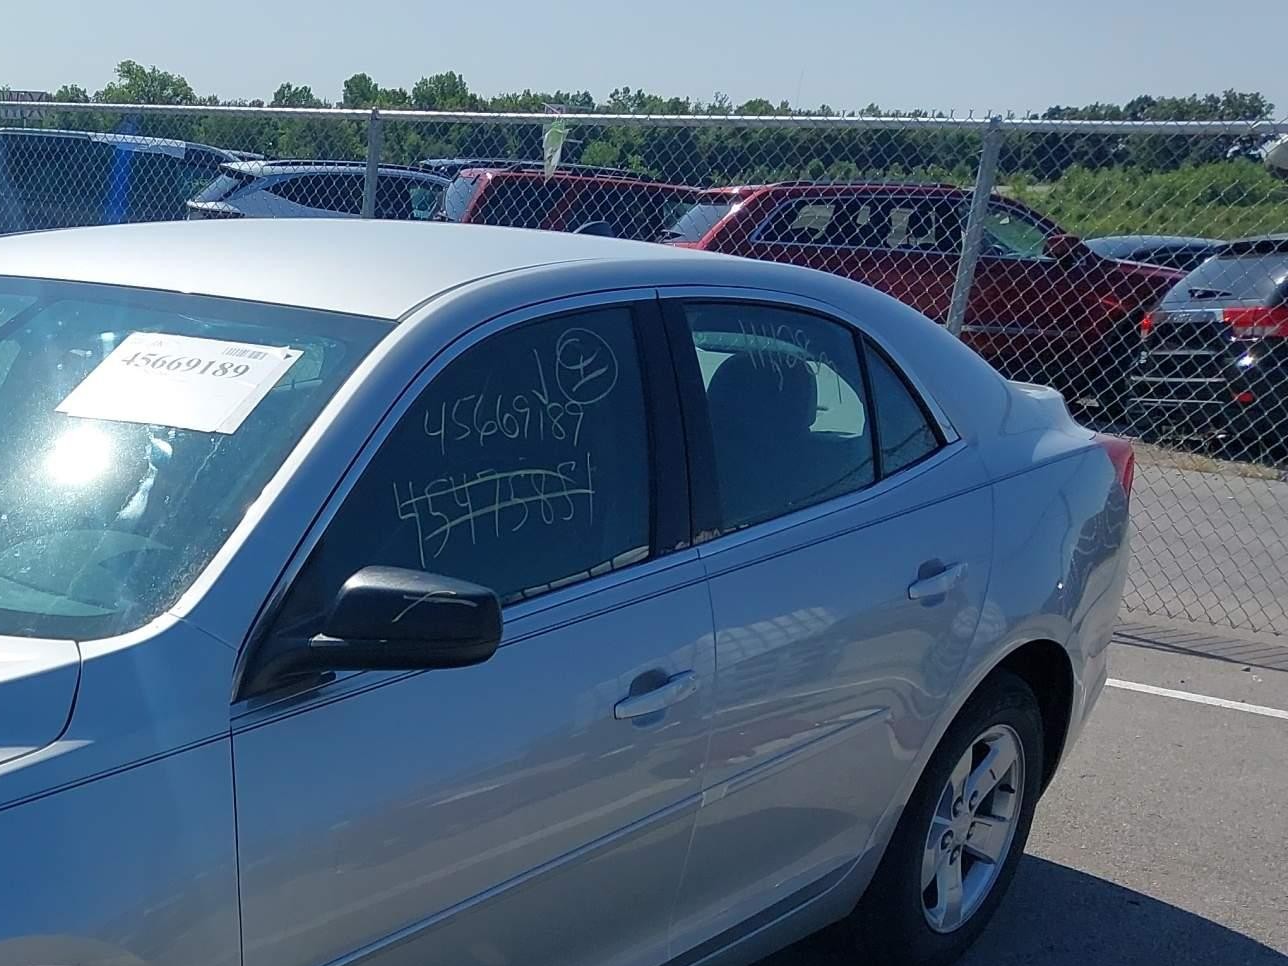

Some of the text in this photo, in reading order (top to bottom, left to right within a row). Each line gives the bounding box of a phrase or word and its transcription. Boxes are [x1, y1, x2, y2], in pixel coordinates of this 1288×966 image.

[120, 350, 251, 380] 45669189
[423, 392, 585, 455] 45669189
[392, 452, 594, 568] 45475851
